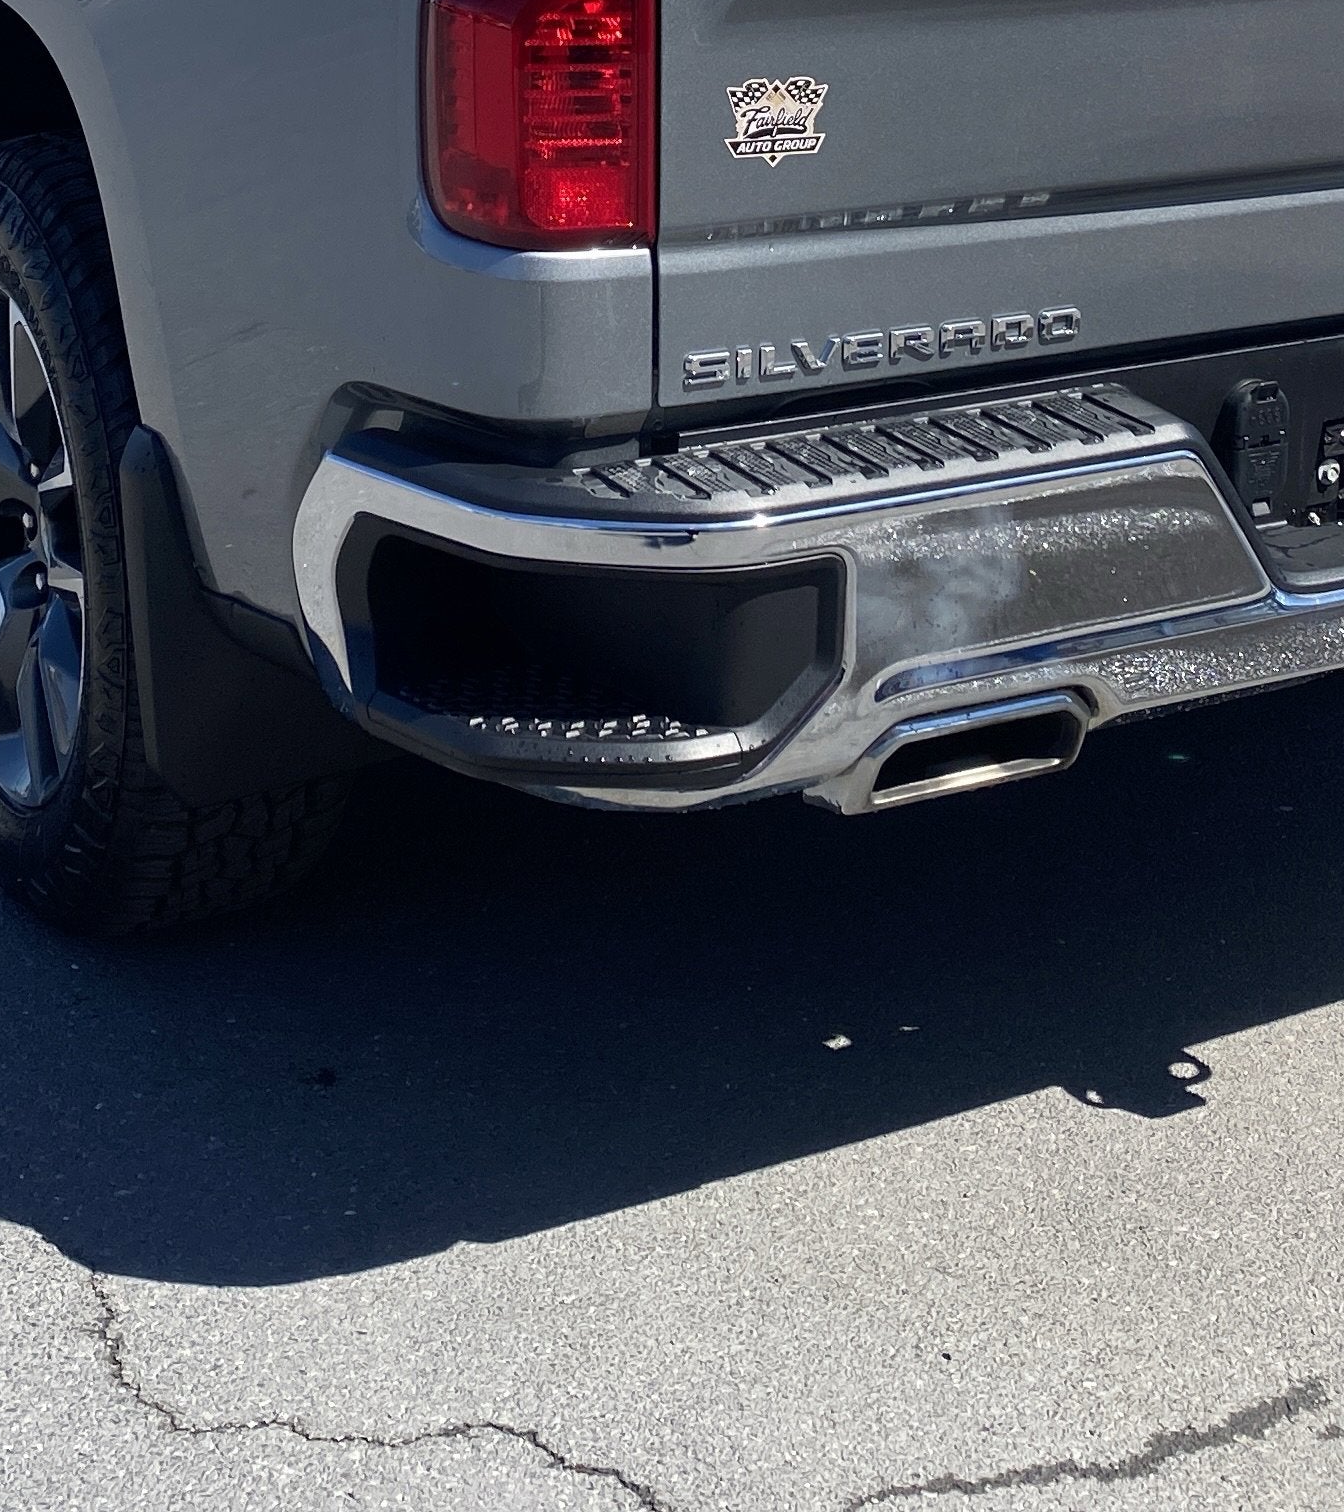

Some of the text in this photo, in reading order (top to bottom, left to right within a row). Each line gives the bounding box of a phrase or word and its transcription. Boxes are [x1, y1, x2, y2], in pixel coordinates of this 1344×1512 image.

[741, 105, 814, 136] Fairfield
[737, 138, 817, 154] AUTO GROUP
[683, 306, 1082, 391] SILVERADO
